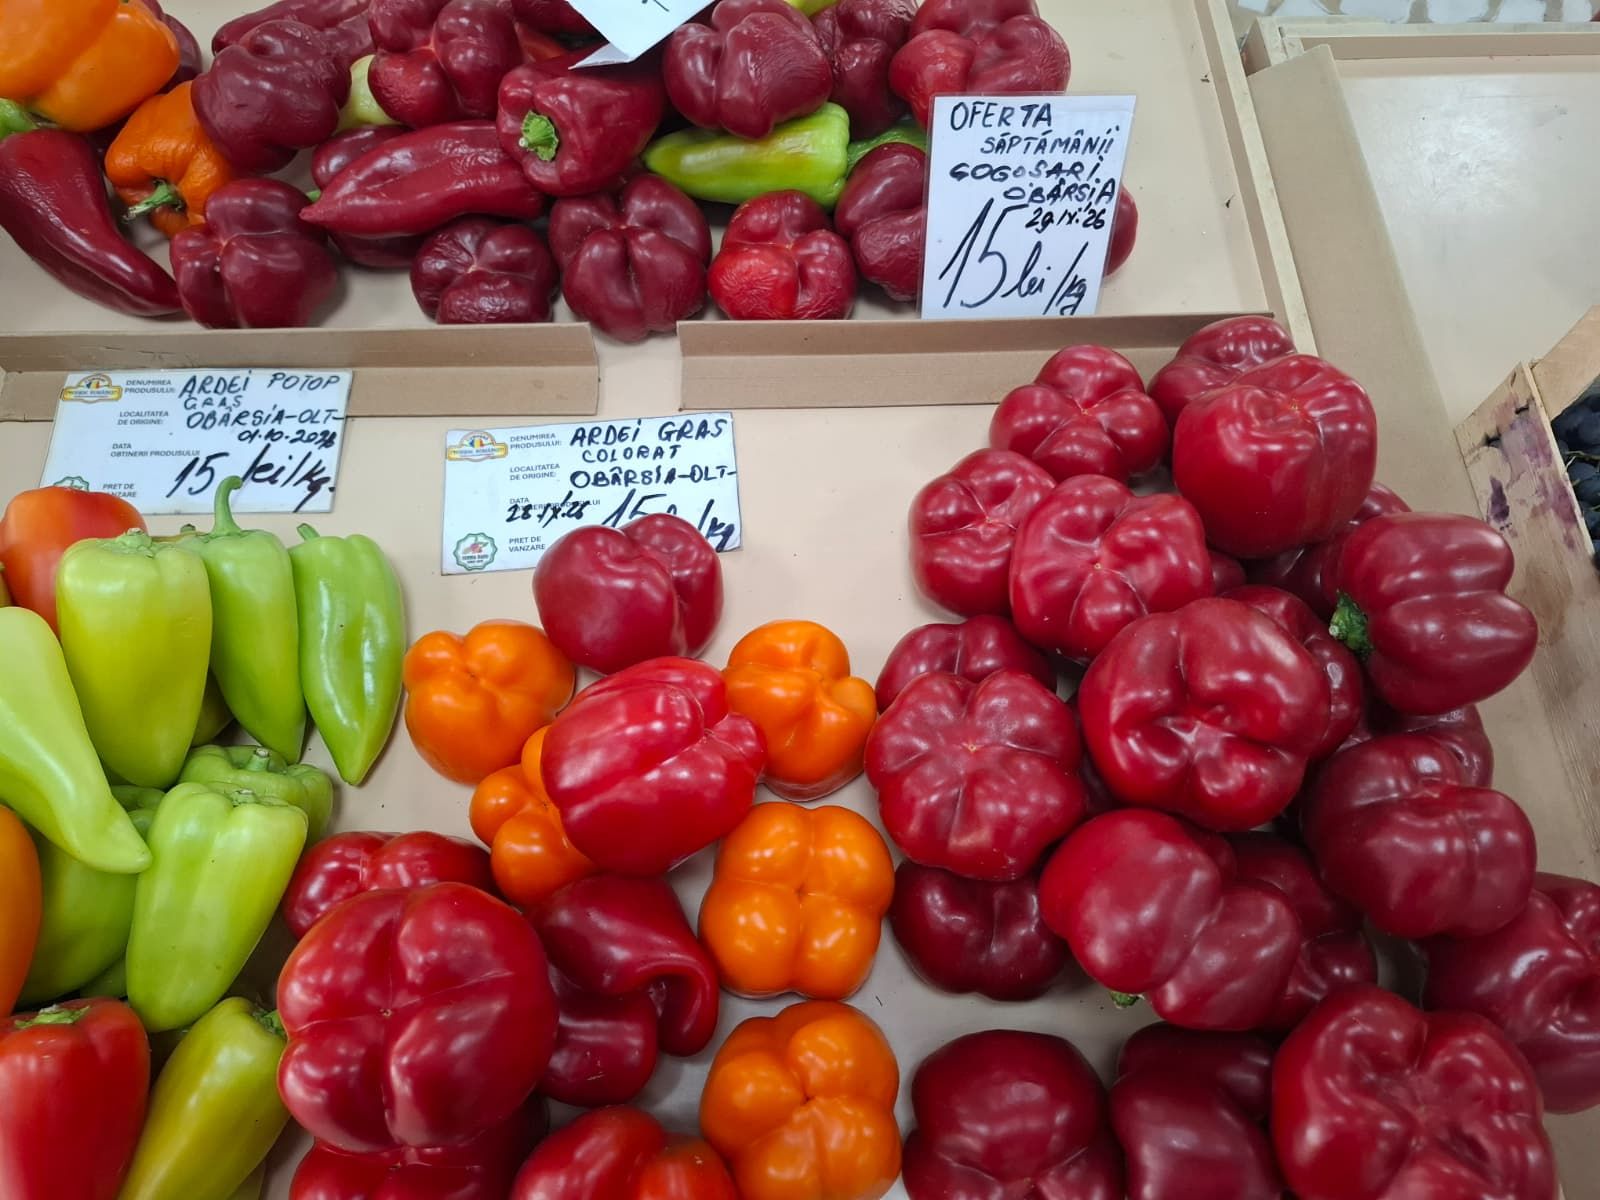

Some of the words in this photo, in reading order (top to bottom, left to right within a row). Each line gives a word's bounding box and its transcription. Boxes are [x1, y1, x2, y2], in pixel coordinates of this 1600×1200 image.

[951, 101, 1053, 131] OFERTA
[938, 198, 1029, 309] 15
[267, 372, 340, 391] POTOP
[183, 395, 243, 410] GRAS
[510, 433, 556, 442] DENUMIREA
[658, 419, 727, 442] GRAS
[582, 445, 682, 463] COLORAT
[166, 452, 229, 498] 15
[510, 463, 560, 473] LOCALITATEA
[509, 543, 545, 553] VANZARE
[530, 535, 541, 543] DE
